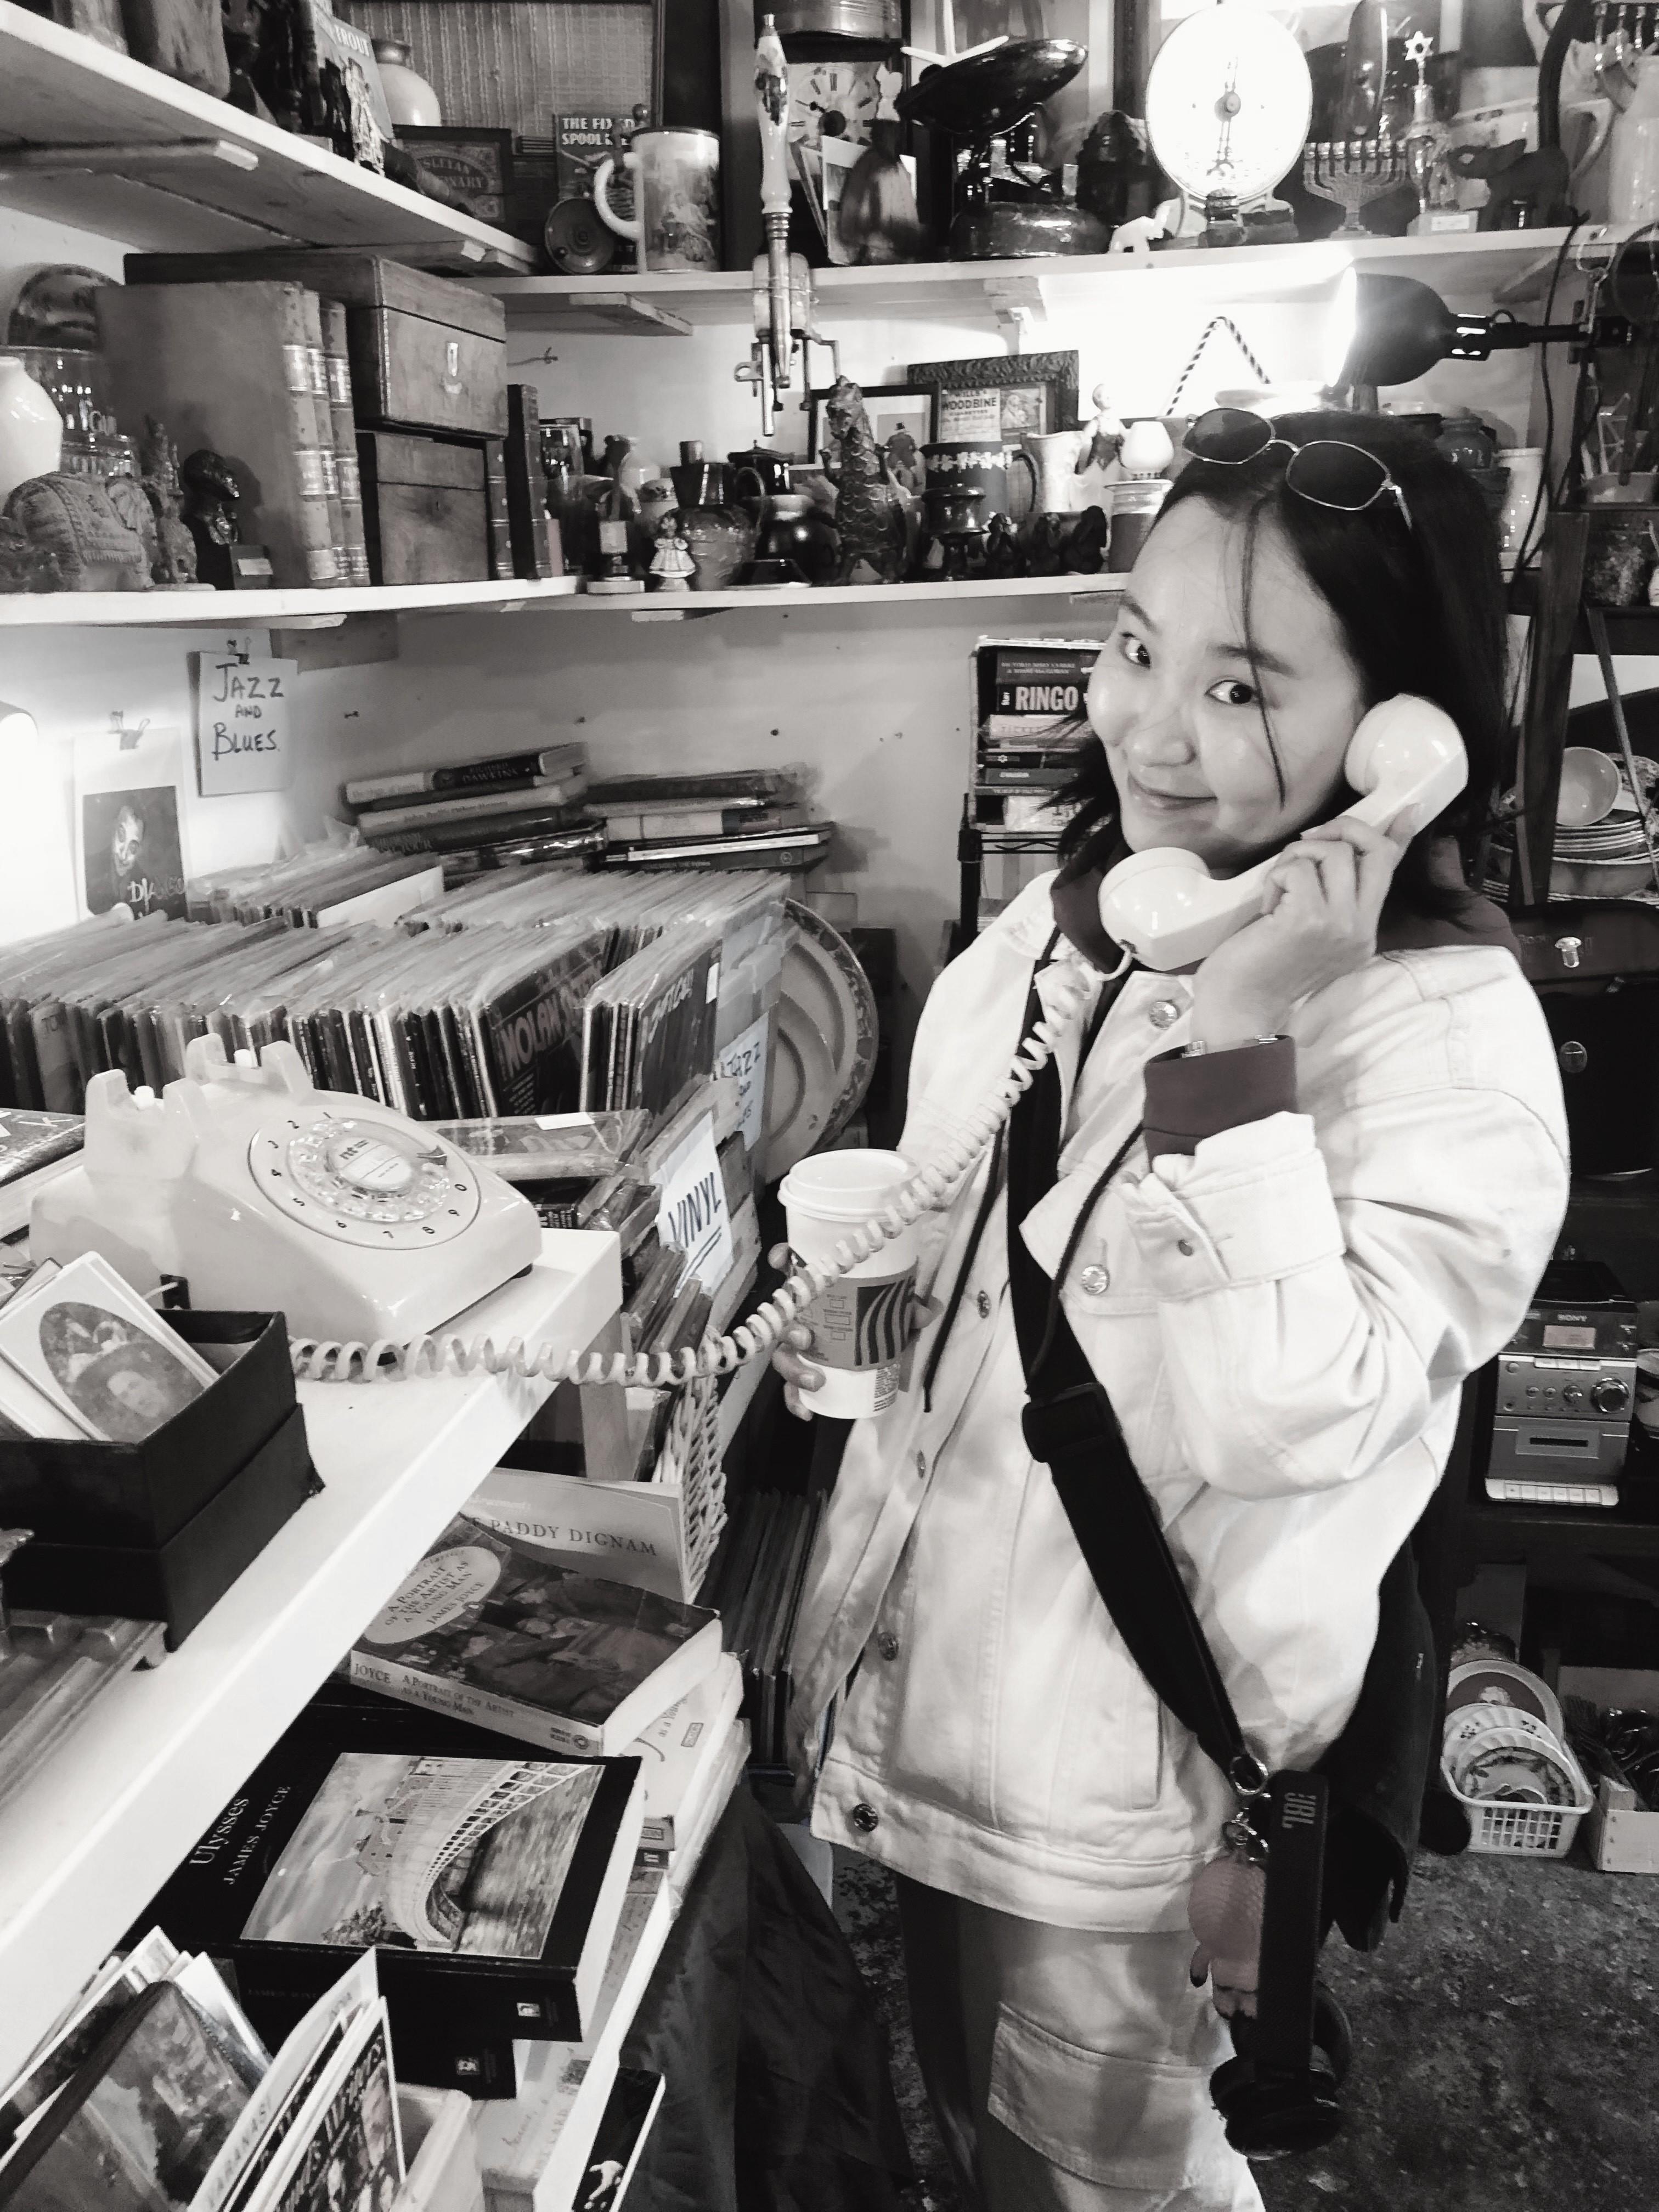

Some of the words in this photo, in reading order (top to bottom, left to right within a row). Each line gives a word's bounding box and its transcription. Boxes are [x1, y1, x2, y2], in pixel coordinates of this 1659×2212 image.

[562, 118, 588, 129] THE
[561, 133, 603, 145] SPOOL
[213, 663, 284, 702] JAZZ
[1015, 686, 1079, 710] RINGO
[235, 704, 262, 718] AND
[500, 993, 562, 1078] NOLAN
[287, 1120, 300, 1129] 2
[292, 1198, 305, 1206] 5
[448, 1209, 460, 1217] 9
[668, 1171, 721, 1248] VINYL
[335, 1220, 347, 1228] 6
[382, 1230, 394, 1239] 7
[422, 1226, 435, 1234] 8
[1557, 1313, 1588, 1322] SONY
[490, 1519, 560, 1539] PADDY
[569, 1528, 657, 1556] DIGNAM
[385, 1615, 398, 1626] OF
[398, 1600, 420, 1614] THE
[420, 1571, 455, 1600] ARTIST
[456, 1560, 469, 1571] AS
[387, 1604, 399, 1612] A
[396, 1566, 446, 1604] PORTRAIT
[410, 1590, 448, 1615] YOUNG
[445, 1571, 472, 1590] MAN
[426, 1602, 458, 1625] JAMES
[455, 1581, 484, 1604] JOYCE
[354, 1663, 392, 1684] JOYCE
[402, 1674, 410, 1684] A
[658, 1729, 669, 1738] as
[1282, 1792, 1316, 1829] JBL
[189, 1798, 249, 1864] Ulysses
[223, 1836, 261, 1885] JAMES
[254, 1786, 291, 1831] JOYCE
